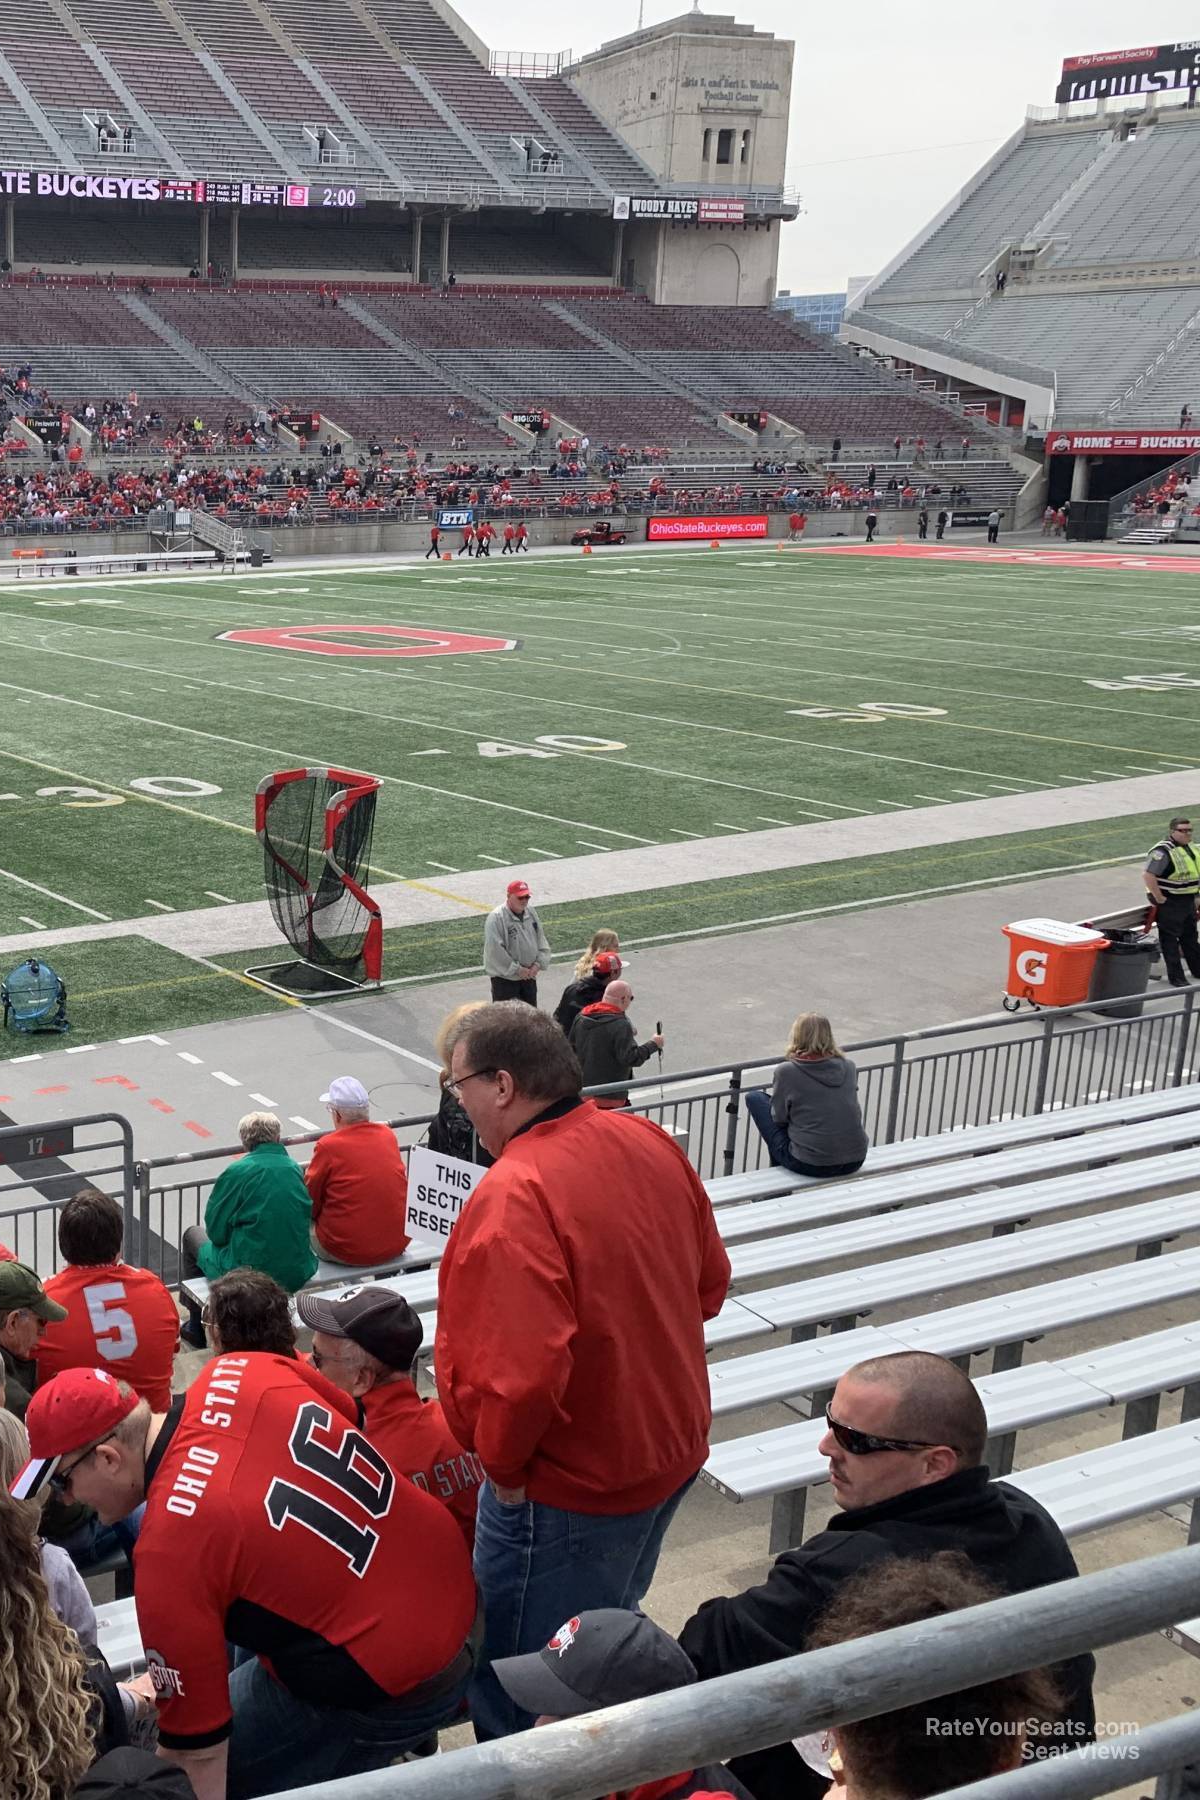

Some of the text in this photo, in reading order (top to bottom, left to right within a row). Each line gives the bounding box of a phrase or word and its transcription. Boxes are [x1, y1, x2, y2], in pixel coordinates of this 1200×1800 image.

[1078, 49, 1153, 65] Pay Forward Society
[704, 90, 759, 101] Football Center
[37, 172, 160, 201] BUCKEYES
[322, 188, 355, 206] 2:00
[632, 199, 666, 212] WOODY
[667, 200, 698, 213] HAYES
[1073, 436, 1112, 448] HOME
[440, 512, 469, 525] BTN
[650, 520, 766, 536] OhioStateBuckeyes.com
[785, 702, 949, 723] 50
[476, 734, 628, 760] 40
[34, 775, 224, 808] 30
[27, 1136, 45, 1156] 17
[435, 1163, 472, 1191] THIS
[416, 1184, 467, 1213] SECTI
[83, 1281, 138, 1361] 5
[200, 1357, 249, 1428] STATE
[166, 1446, 221, 1517] OHIO
[264, 1400, 396, 1579] 16
